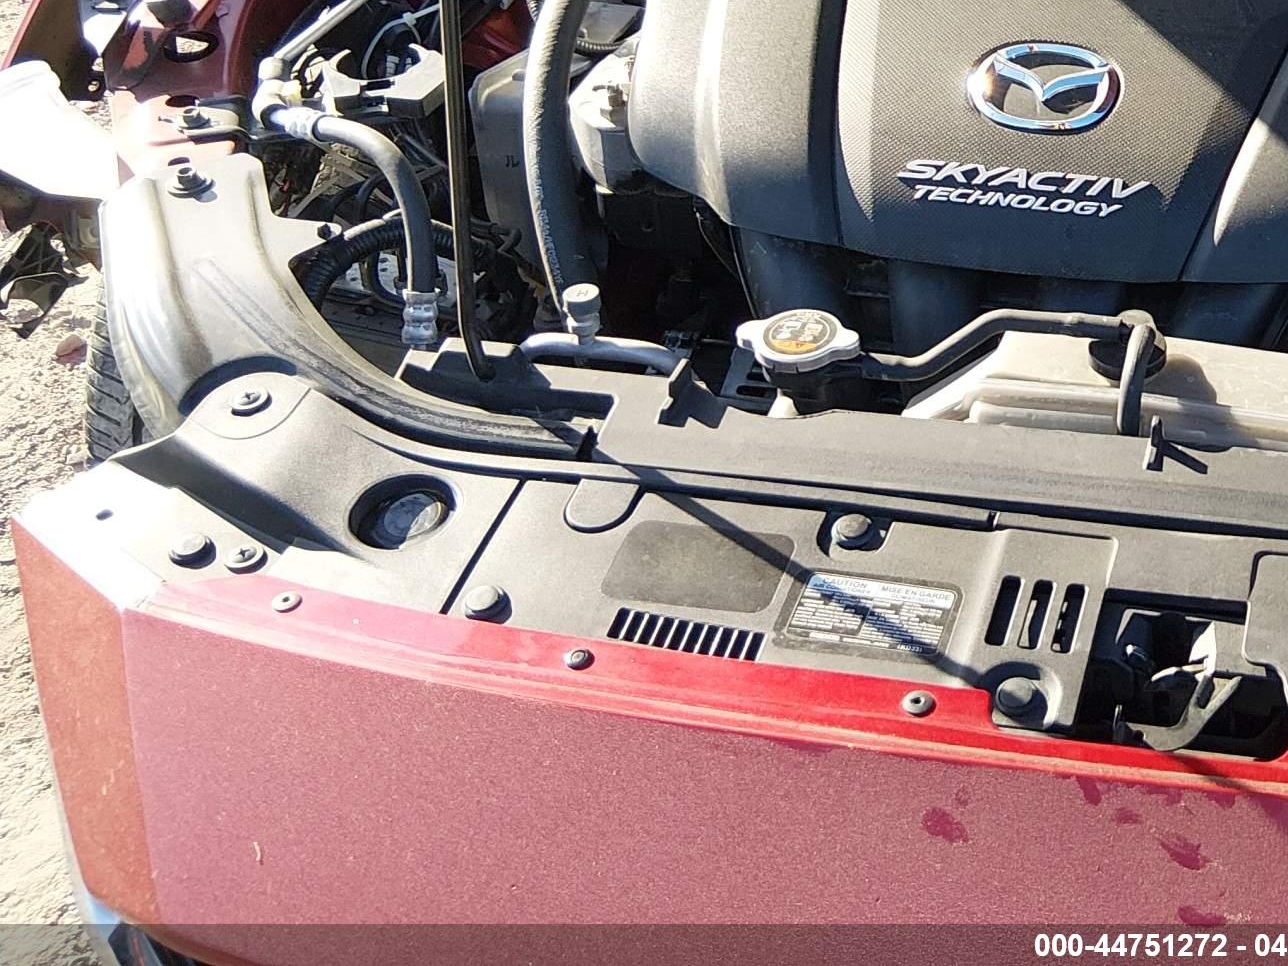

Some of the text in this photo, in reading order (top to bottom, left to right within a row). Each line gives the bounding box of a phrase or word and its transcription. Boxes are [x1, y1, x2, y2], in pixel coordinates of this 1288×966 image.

[897, 159, 1150, 200] SKYACTIV
[912, 184, 1124, 218] TECHNOLOGY
[822, 577, 868, 589] CAUTION
[905, 588, 918, 597] EN
[918, 590, 952, 601] GARDE
